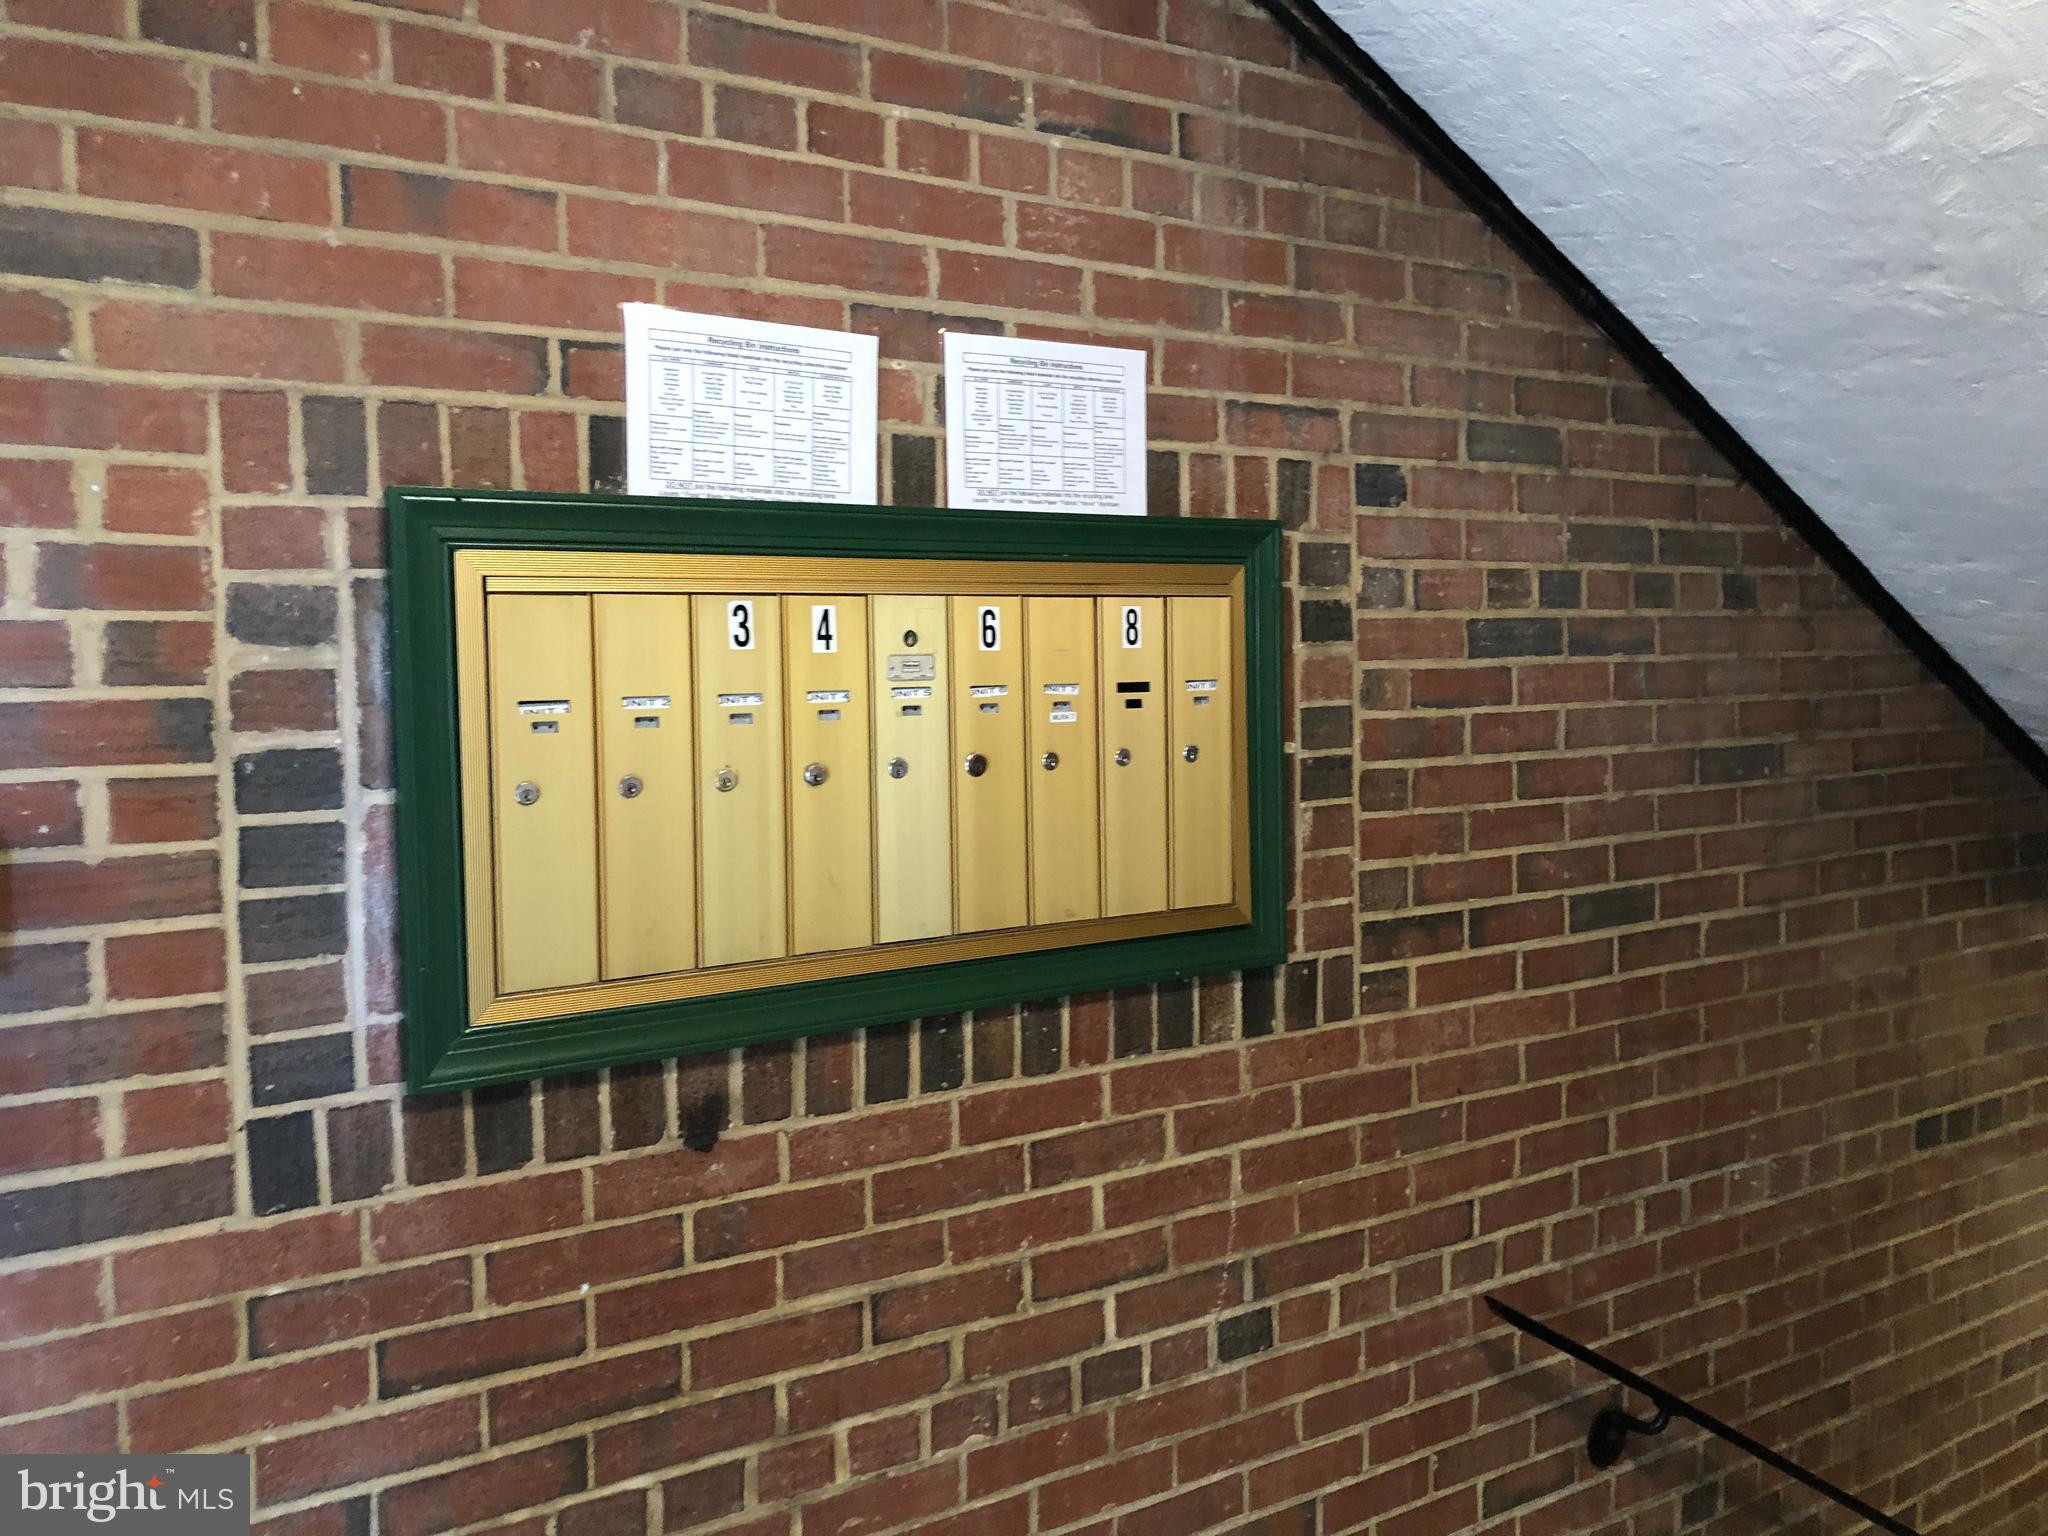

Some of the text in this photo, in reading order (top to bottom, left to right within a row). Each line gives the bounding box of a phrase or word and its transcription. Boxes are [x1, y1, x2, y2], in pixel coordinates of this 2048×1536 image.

[732, 604, 750, 647] 3
[817, 609, 833, 650] 4
[982, 609, 996, 648] 6
[1126, 608, 1138, 645] 8
